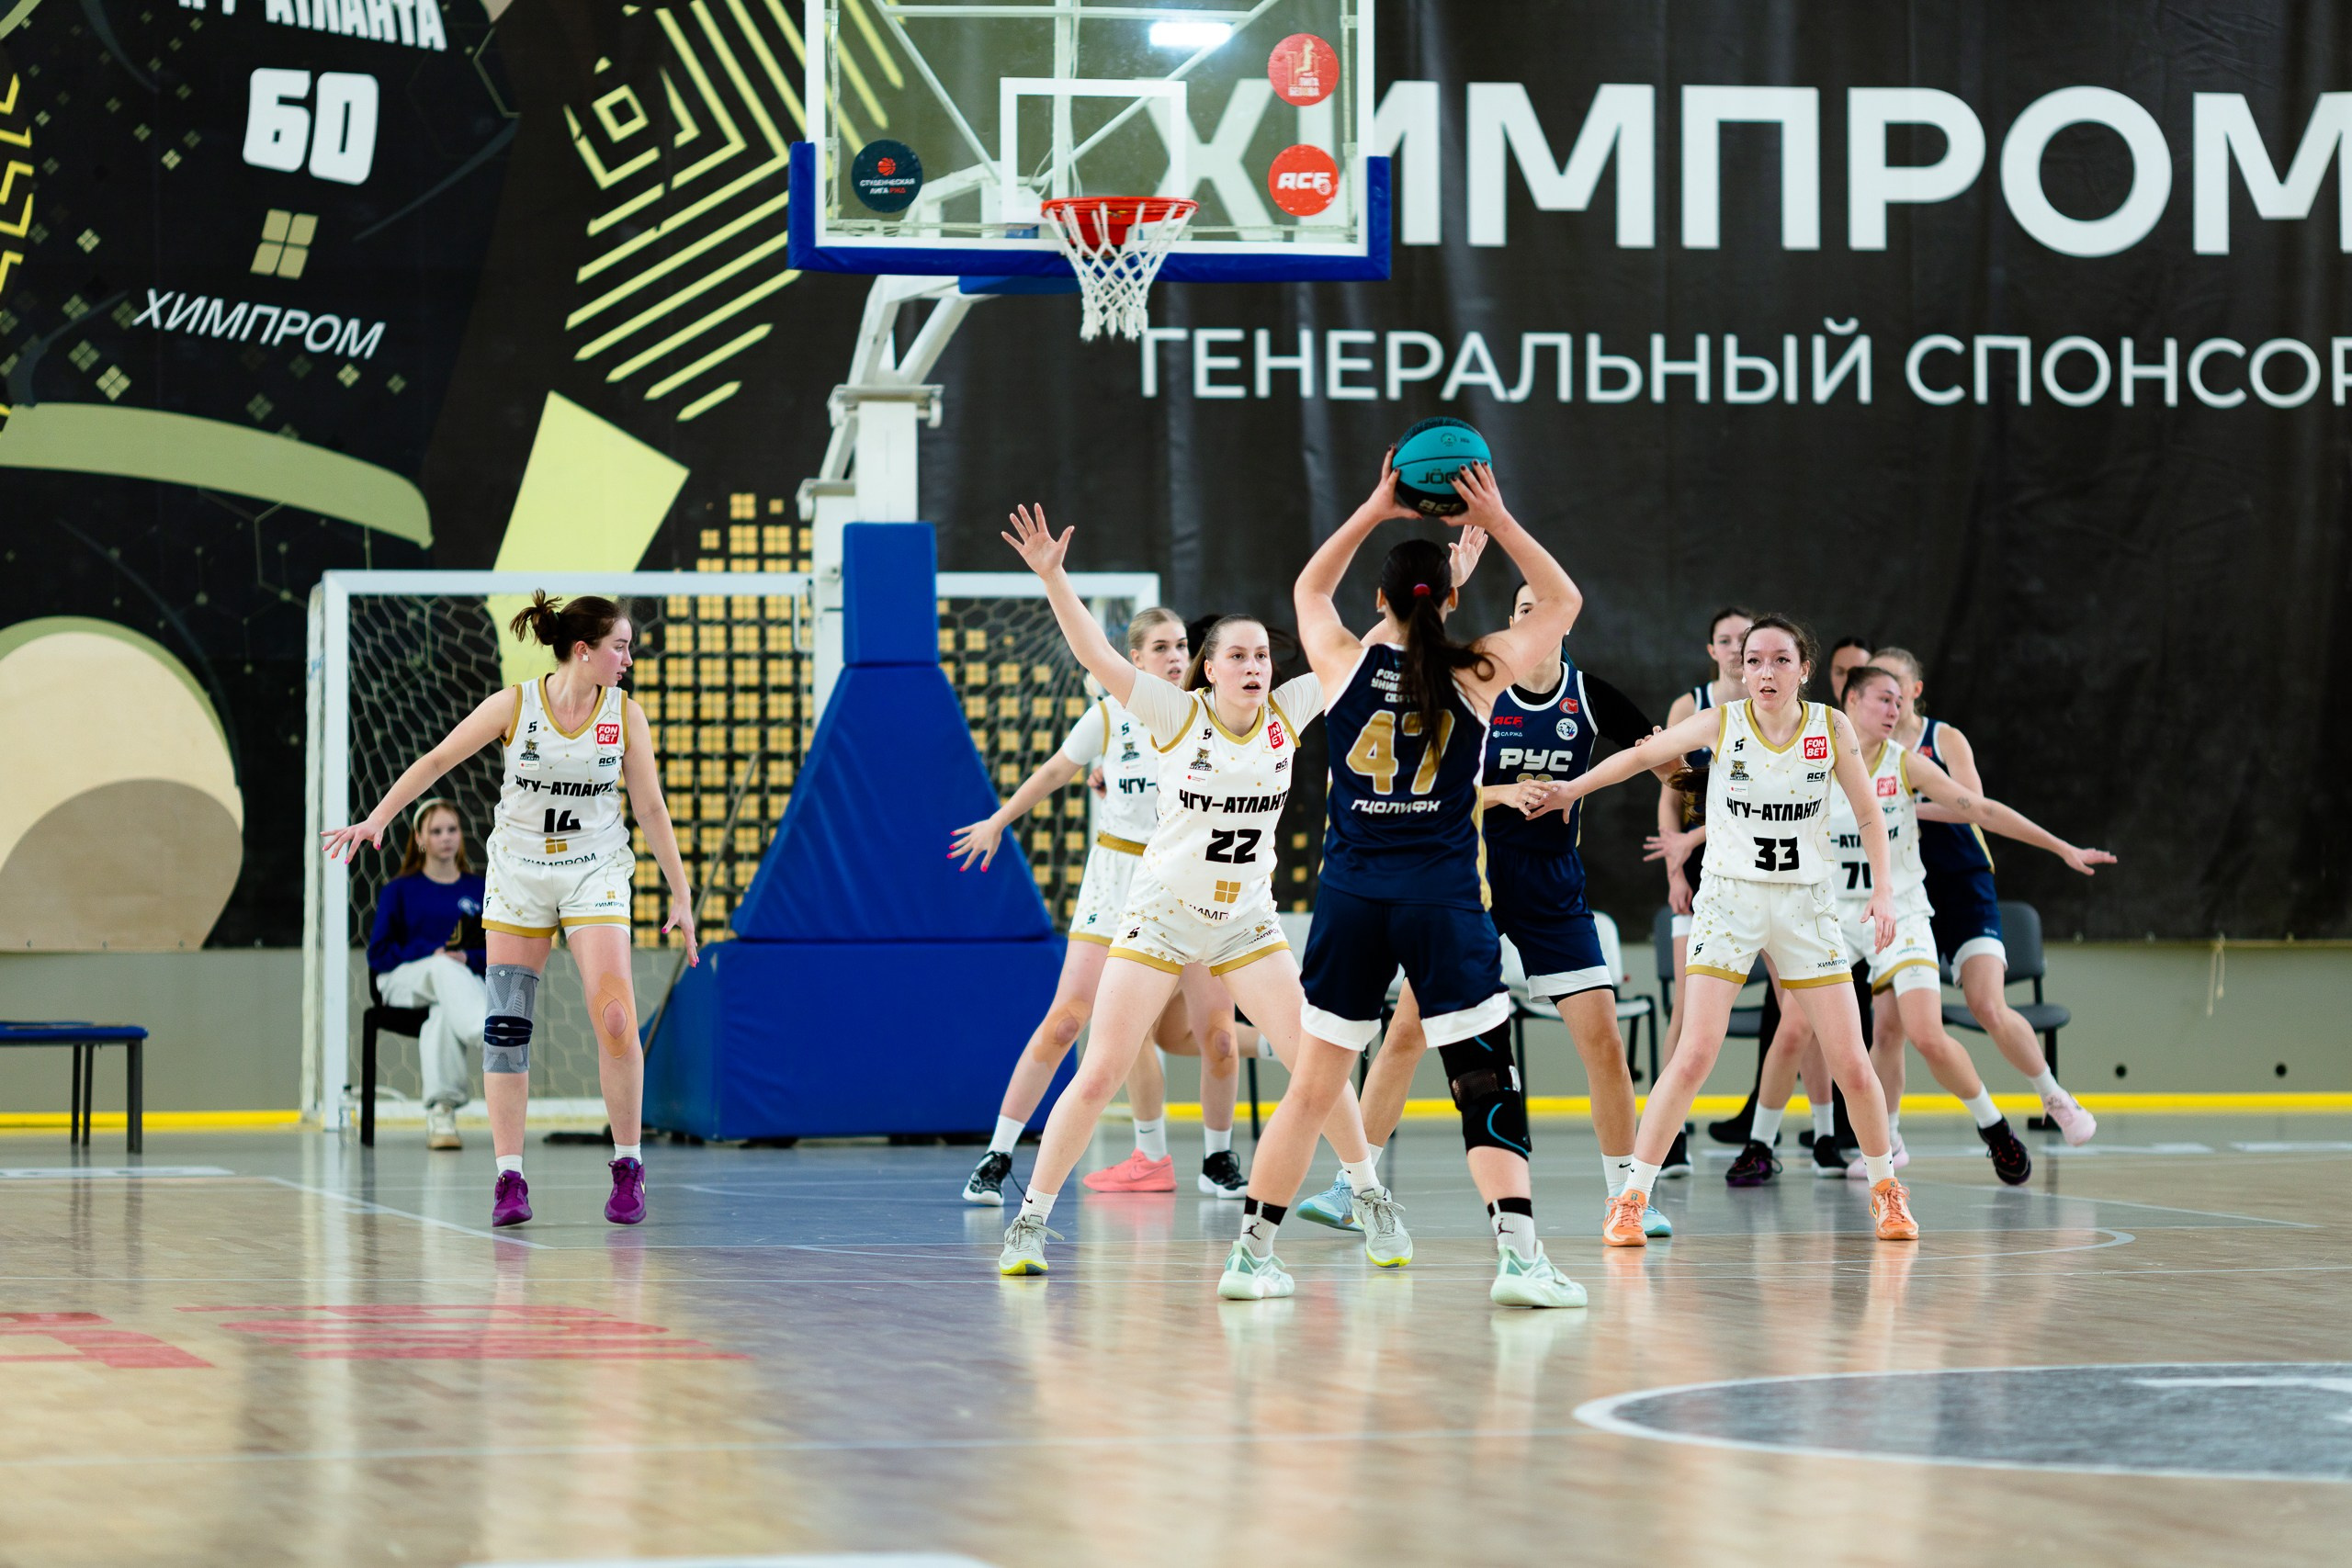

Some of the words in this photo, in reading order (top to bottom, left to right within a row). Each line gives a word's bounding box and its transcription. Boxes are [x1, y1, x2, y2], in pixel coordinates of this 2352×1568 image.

[243, 67, 379, 185] 60
[1135, 77, 2352, 258] ХИМПРОМ
[133, 288, 386, 360] ХИМПРОМ
[1140, 316, 1872, 406] ГЕНЕРАЛЬНЫЙ
[598, 725, 618, 734] FON
[598, 734, 617, 742] BET
[1346, 709, 1455, 795] 47
[1805, 739, 1826, 748] FON
[1806, 747, 1826, 757] BET
[1498, 748, 1573, 773] РУС
[1179, 788, 1288, 813] ЧГУ-АТЛАНТ
[1351, 799, 1442, 814] ГЦОЛИФК
[543, 807, 582, 833] 14
[1204, 828, 1262, 864] 22
[1753, 836, 1800, 872] 33
